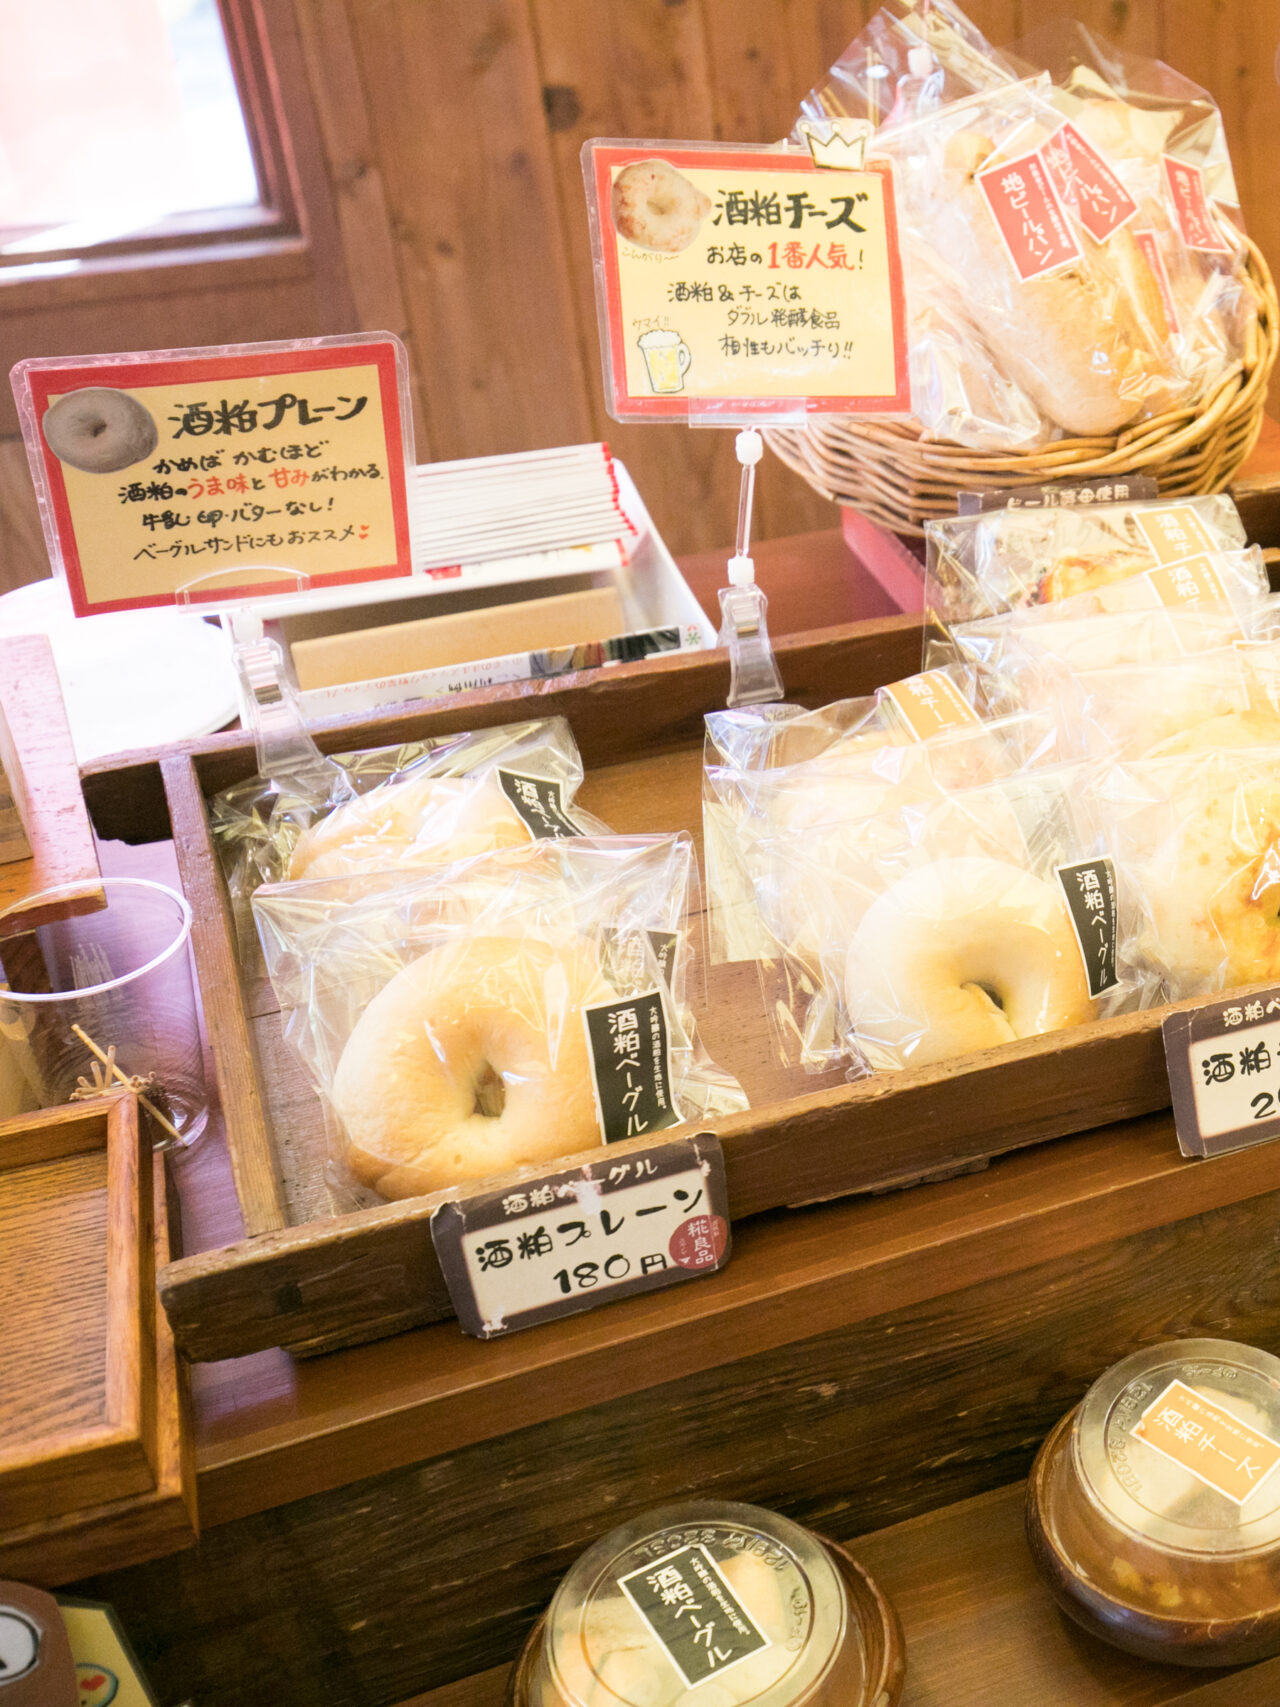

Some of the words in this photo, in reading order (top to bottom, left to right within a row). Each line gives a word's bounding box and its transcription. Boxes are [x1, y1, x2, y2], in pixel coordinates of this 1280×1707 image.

[713, 190, 868, 233] 酒粕チーズ
[1000, 172, 1053, 265] 地ビールパン
[167, 393, 368, 439] 酒粕プレーン
[1076, 869, 1108, 986] 酒粕ベーグル
[608, 1008, 648, 1136] 酒粕ベーグル
[475, 1188, 703, 1273] 酒粕プレーン
[687, 1218, 714, 1265] 糀良品
[554, 1253, 668, 1294] 180円
[1154, 1407, 1260, 1480] 酒粕チーズ
[646, 1565, 732, 1668] 酒粕ベーグル
